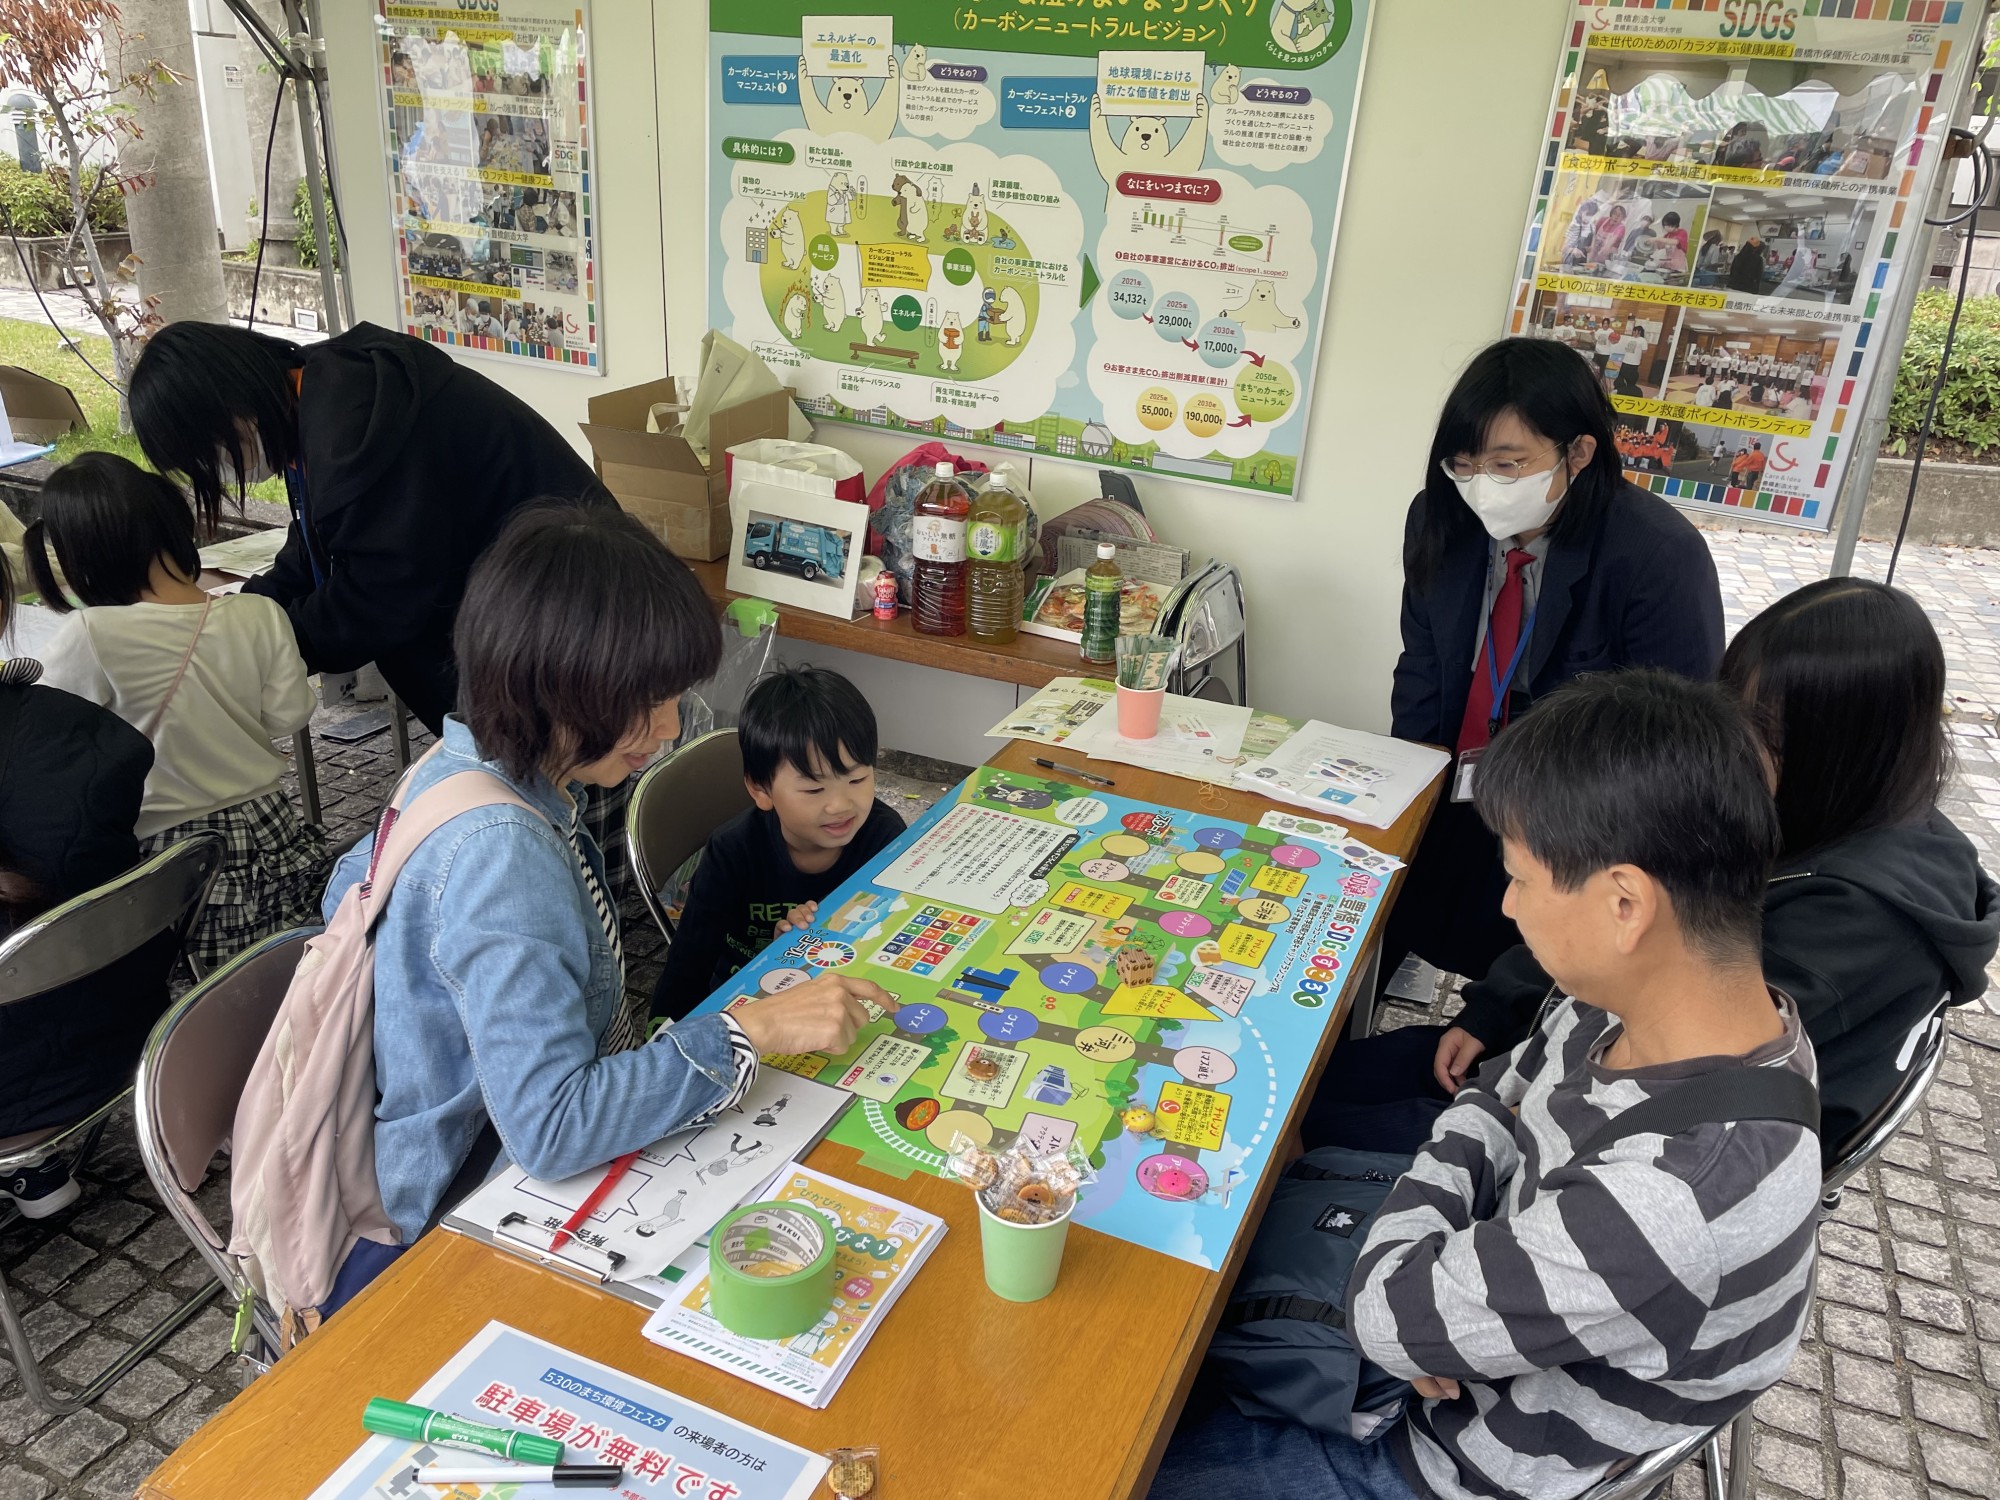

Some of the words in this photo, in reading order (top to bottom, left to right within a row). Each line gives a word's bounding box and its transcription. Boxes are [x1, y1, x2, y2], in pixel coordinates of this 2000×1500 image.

[1719, 0, 1798, 41] SDGs
[816, 32, 877, 46] エネルギーの
[829, 49, 862, 63] 最適化
[728, 66, 797, 81] カーボンニュートラル
[940, 66, 978, 78] どうやるの？
[1108, 66, 1193, 83] 地球環境における
[1007, 88, 1088, 103] カーボンニュートラル
[1105, 84, 1191, 101] 新たな価値を創出
[1255, 88, 1300, 100] どうやるの？
[1226, 107, 1315, 121] グループ内外との連携によるまち
[1224, 118, 1314, 131] づくりを通じたカーボンニュート
[732, 143, 783, 157] 具体的には？
[894, 158, 954, 173] 行政や企業との連携
[742, 176, 761, 186] 建物の
[1127, 177, 1210, 196] なにをいつまでに？
[742, 185, 807, 200] カーボンニュートラル化
[991, 189, 1060, 204] 生物多様性の取り組み
[812, 252, 835, 262] サービス
[946, 262, 972, 273] 事業活動
[1121, 277, 1142, 287] 2021年
[1537, 276, 1726, 309] つどいの広場「学生さんとあそぼう」
[1166, 300, 1188, 310] 2025年
[892, 308, 923, 319] エネルギー
[1213, 325, 1235, 336] 2030年
[1255, 372, 1278, 382] 2050年
[1149, 392, 1168, 402] 2025年
[1197, 399, 1217, 409] 2030年
[1240, 395, 1286, 407] ニュートラル
[1612, 397, 1812, 435] マラソン救護ポイントボランティア
[1209, 831, 1226, 844] クイズ
[1058, 968, 1079, 987] クイズ
[908, 1008, 931, 1029] クイズ
[1001, 1013, 1019, 1035] クイズ
[776, 1223, 801, 1241] ASKUL
[543, 1370, 668, 1428] 530のまち環境フェスタ
[673, 1425, 768, 1473] の来場者の方は
[475, 1382, 739, 1500] 駐車場が無料です
